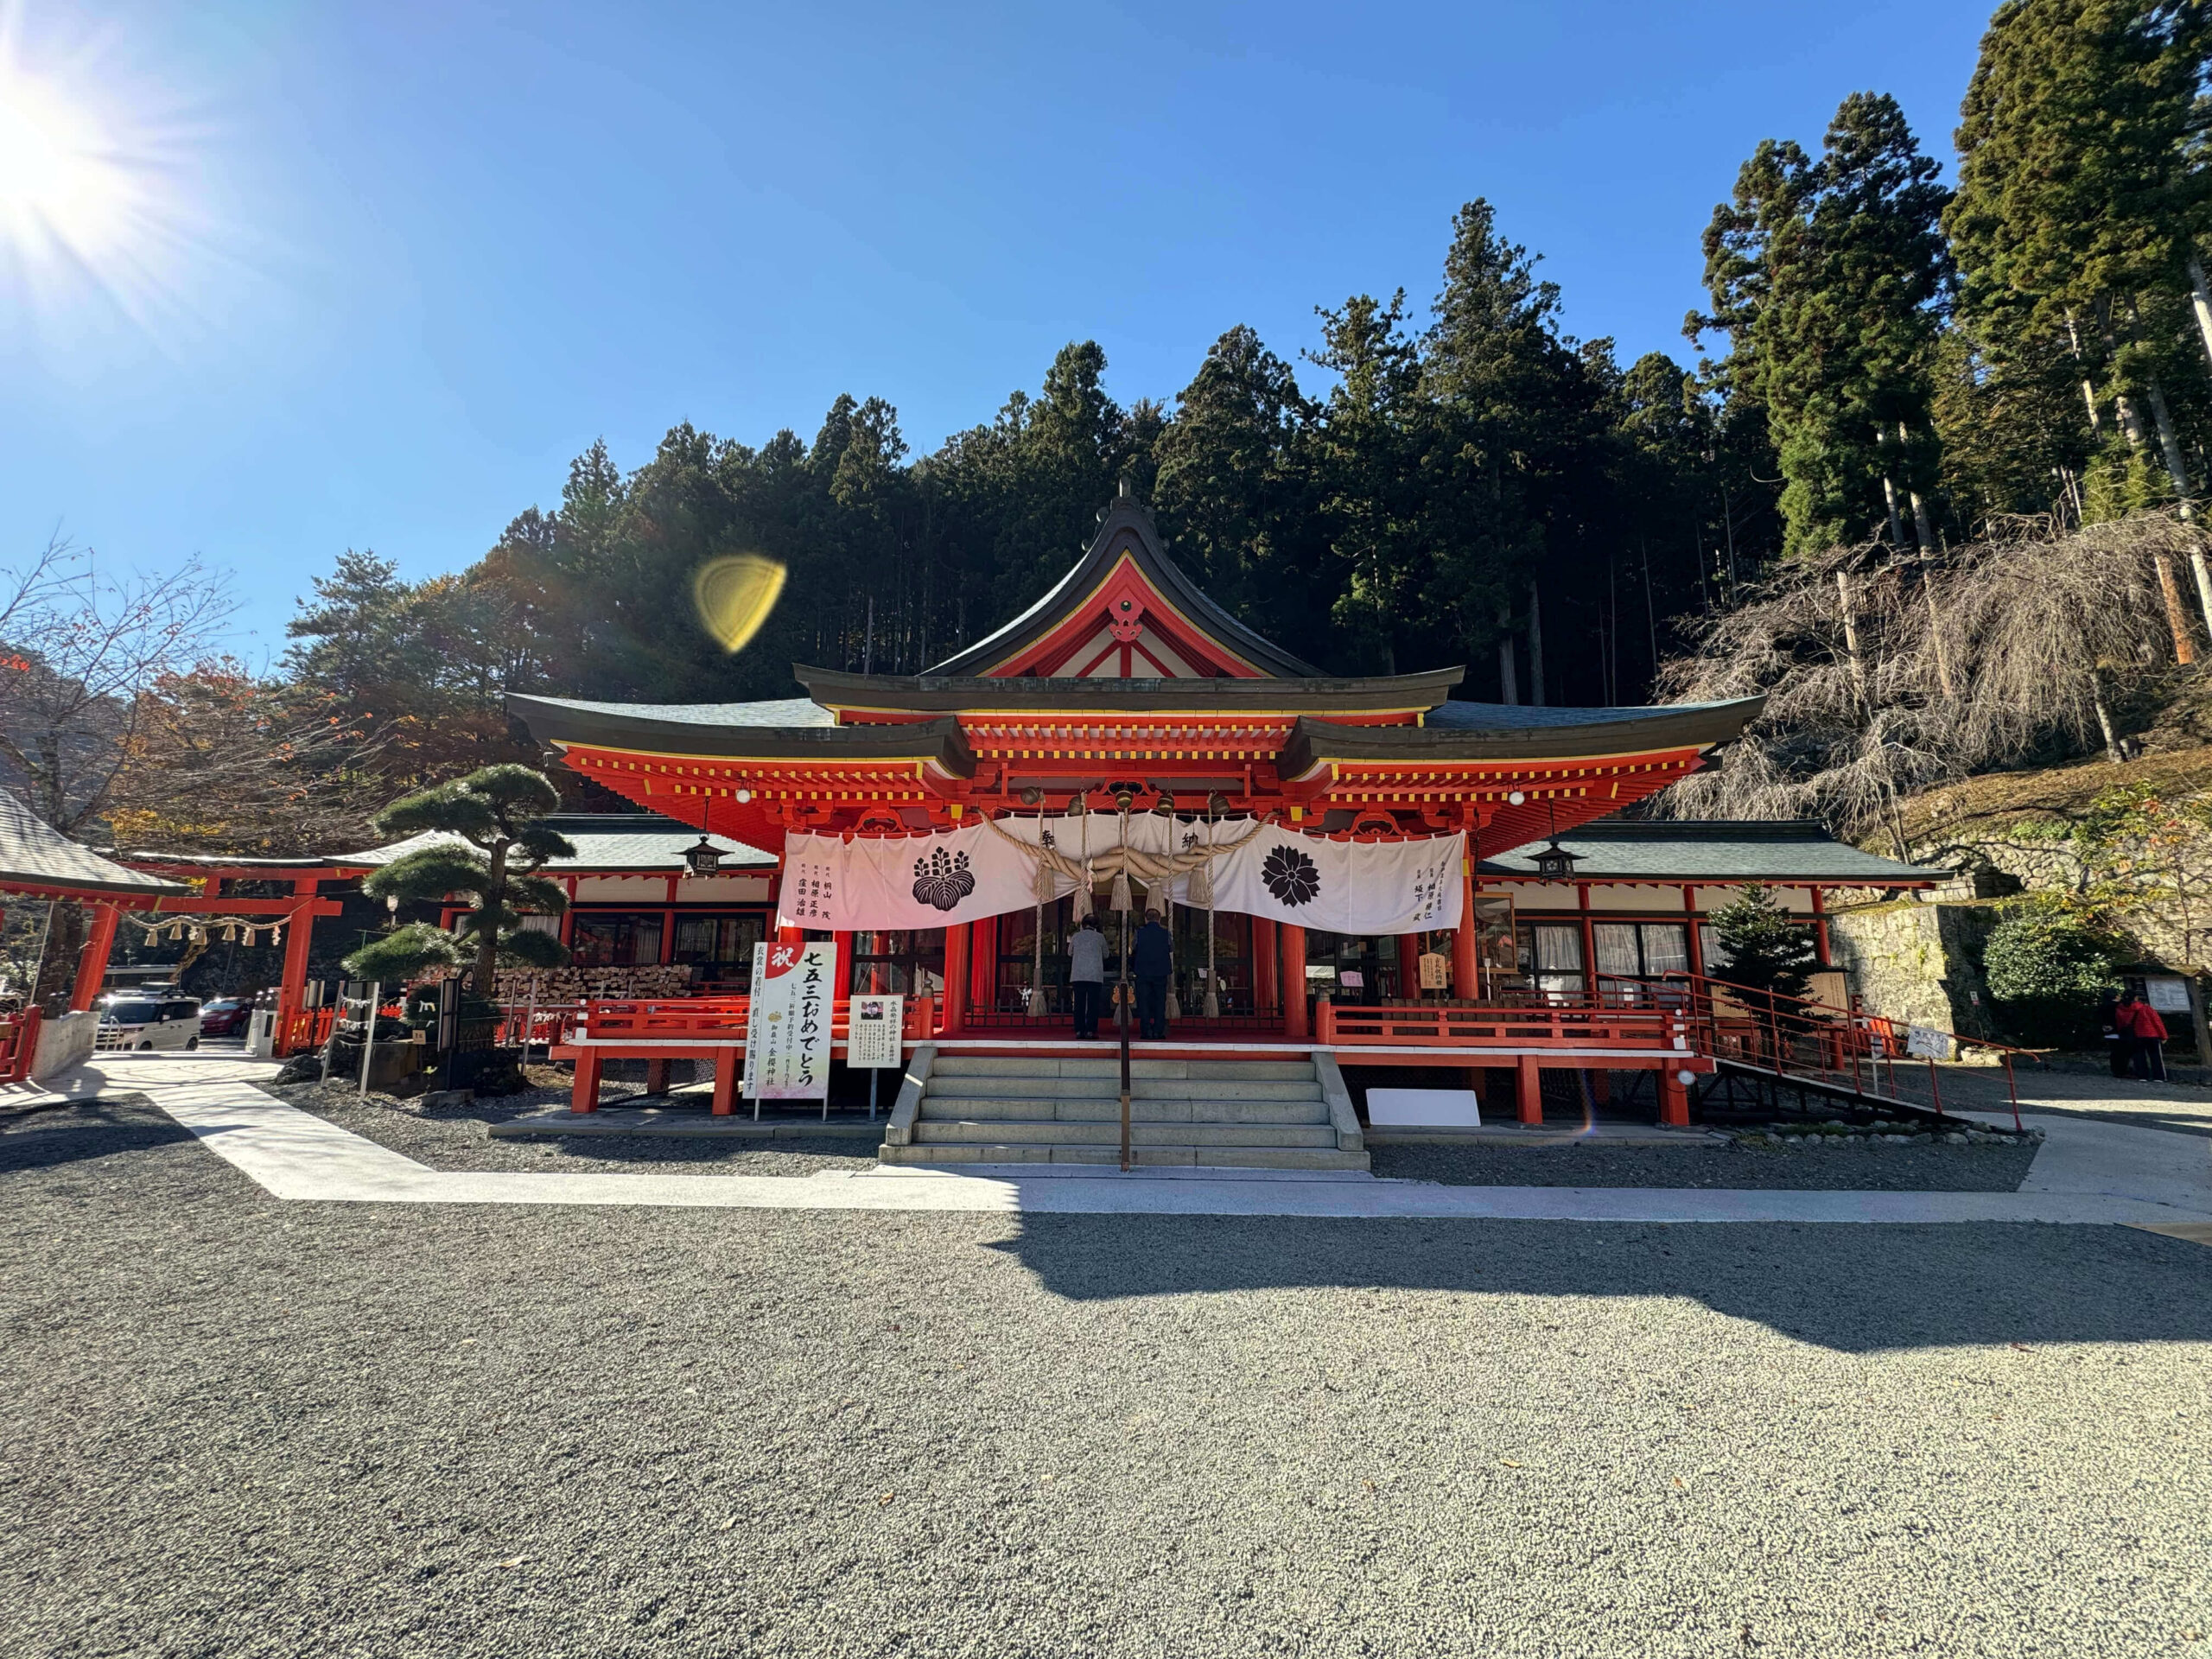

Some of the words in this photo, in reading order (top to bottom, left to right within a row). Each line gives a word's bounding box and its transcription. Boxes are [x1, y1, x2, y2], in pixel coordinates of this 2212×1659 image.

[772, 946, 795, 968] 祝
[798, 952, 823, 1088] 七五三おめでとう
